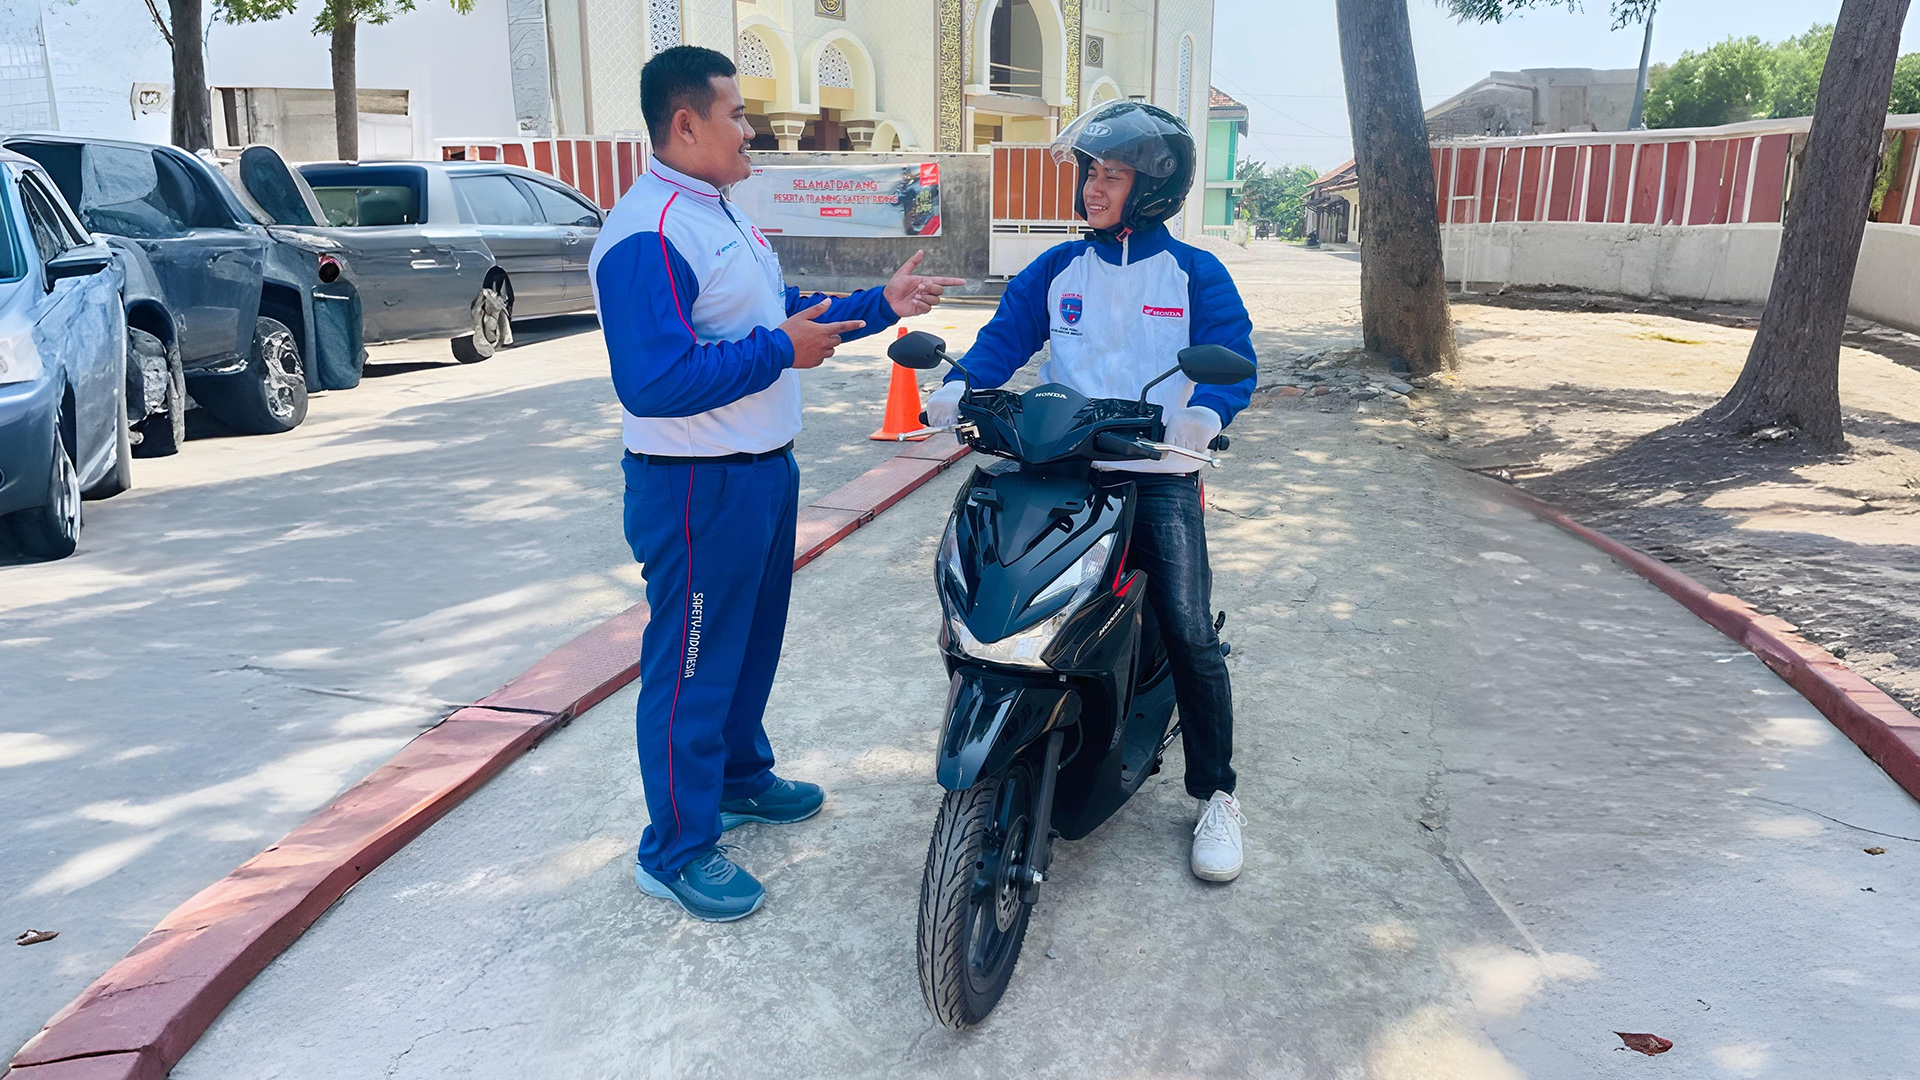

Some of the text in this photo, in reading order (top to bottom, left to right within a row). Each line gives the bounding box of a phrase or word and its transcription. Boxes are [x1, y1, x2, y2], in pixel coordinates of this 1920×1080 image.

[792, 179, 878, 191] SELAMAT DATANG
[773, 193, 899, 204] PESERTA TRAINING SAFETY RIDING
[1034, 391, 1067, 399] HONDA
[1098, 603, 1125, 637] HONDA
[684, 592, 704, 679] SAFETY-INDONESIA
